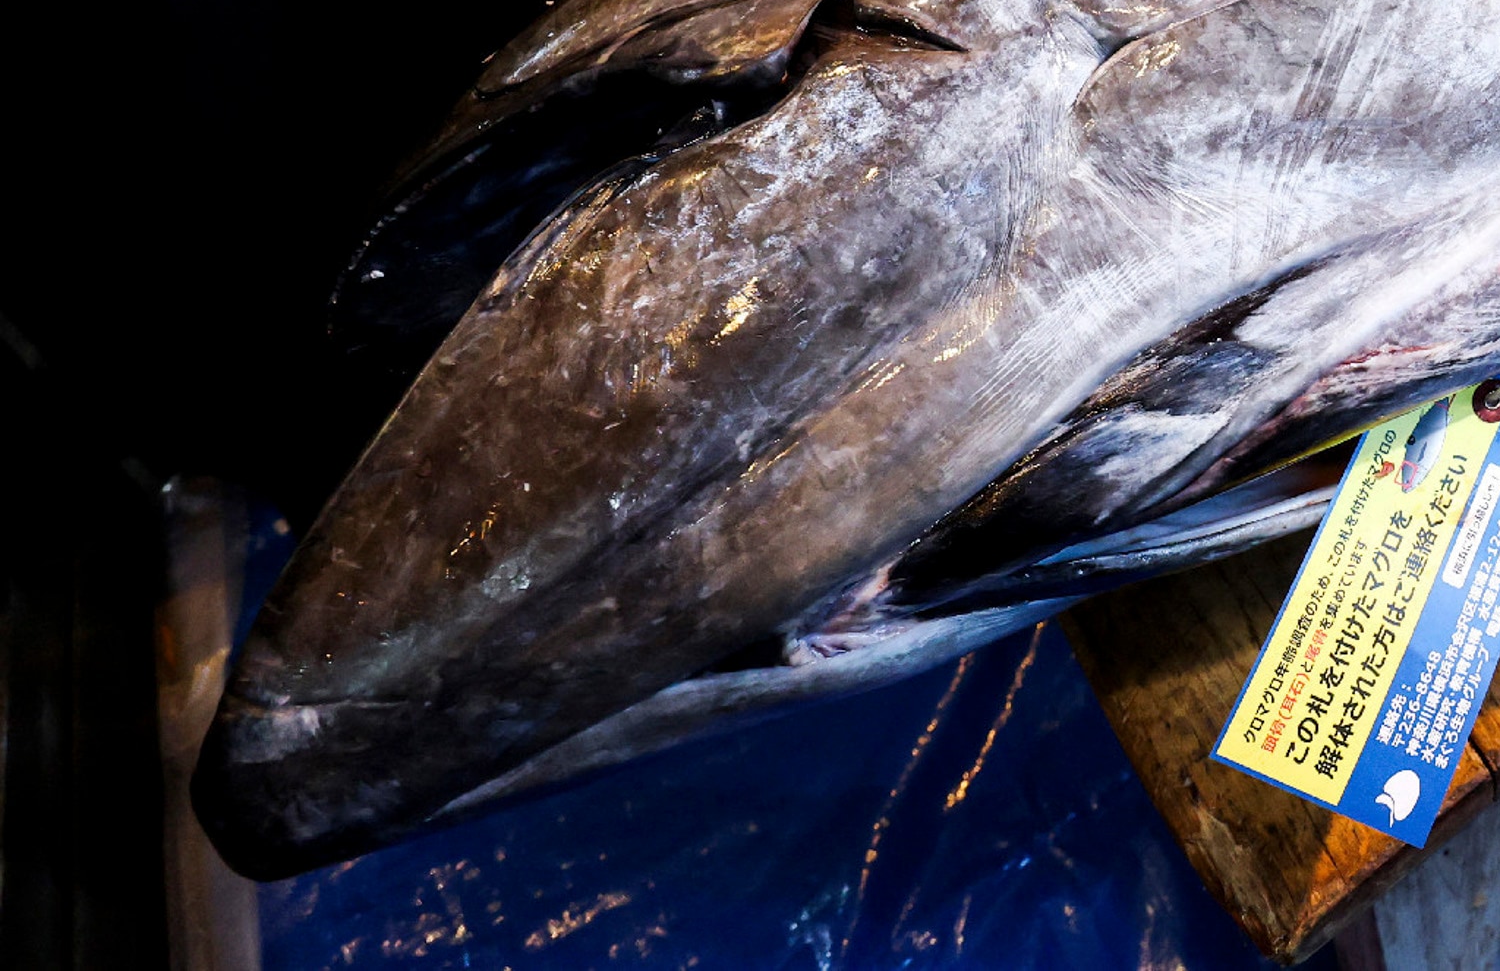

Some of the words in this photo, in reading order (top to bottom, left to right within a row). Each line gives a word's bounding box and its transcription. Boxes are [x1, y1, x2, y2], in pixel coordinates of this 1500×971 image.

[1284, 509, 1414, 765] この札を付けたマグロを
[1314, 452, 1468, 781] 解体された方はご連絡ください
